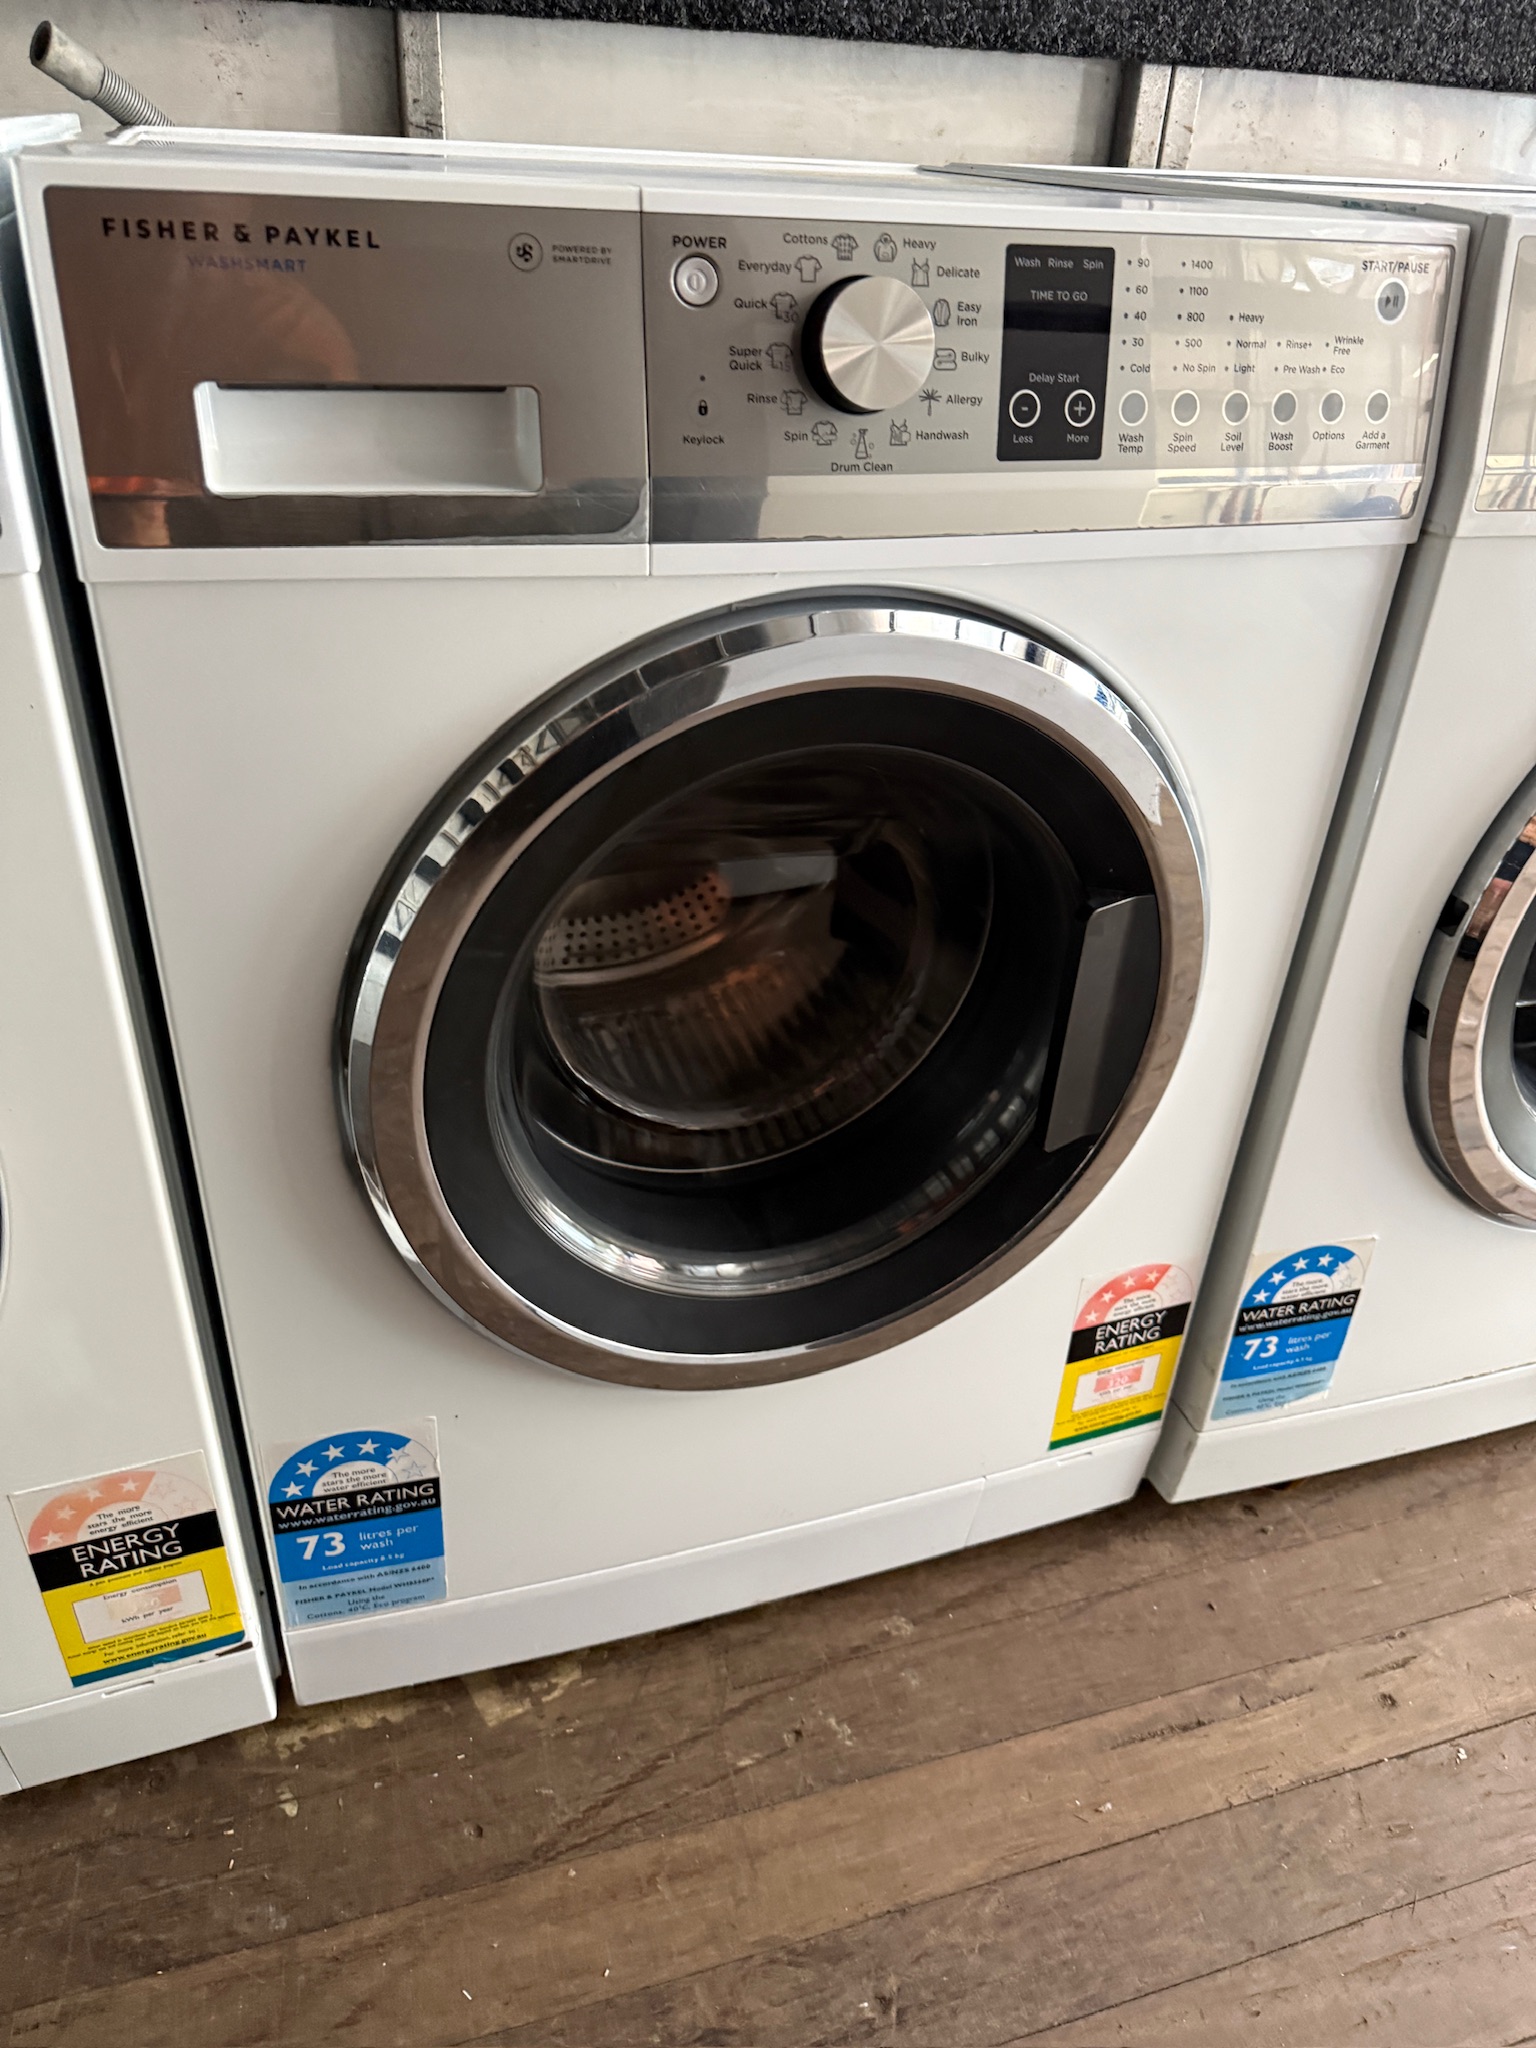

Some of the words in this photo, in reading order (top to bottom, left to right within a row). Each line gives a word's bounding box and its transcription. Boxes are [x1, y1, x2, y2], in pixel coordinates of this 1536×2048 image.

[101, 217, 220, 242] FISHER
[233, 223, 251, 243] &
[264, 225, 380, 249] PAYKEL
[782, 232, 828, 246] Cottons
[672, 235, 727, 249] POWER
[902, 237, 937, 251] Heavy
[551, 244, 598, 254] POWERED
[600, 246, 612, 255] BY
[186, 254, 307, 273] WASHSMART
[551, 255, 612, 265] SMARTDRIVE
[1014, 256, 1042, 270] Wash
[1047, 257, 1074, 270] Rinse
[1082, 258, 1105, 272] Spin
[1137, 258, 1151, 269] 90
[1191, 259, 1214, 271] 1400
[738, 260, 792, 275] Everyday
[936, 266, 981, 279] Delicate
[1361, 259, 1430, 276] START/PAUSE
[1030, 289, 1055, 302] TIME
[1056, 290, 1070, 302] TO
[1071, 290, 1089, 302] GO
[1135, 285, 1149, 296] 60
[1188, 285, 1209, 297] 1100
[733, 298, 768, 311] Quick
[957, 301, 982, 315] Easy
[957, 315, 978, 327] Iron
[1133, 311, 1147, 322] 40
[1186, 312, 1206, 323] 800
[1238, 312, 1265, 325] Heavy
[1131, 337, 1145, 348] 30
[1184, 338, 1203, 349] 500
[1236, 338, 1267, 350] Normal
[1285, 339, 1313, 351] Rinse+
[1334, 335, 1364, 347] Wrinkle
[729, 345, 763, 359] Super
[961, 350, 990, 364] Bulky
[1333, 345, 1351, 356] Free
[729, 359, 763, 373] Quick
[1129, 363, 1151, 374] Cold
[1182, 363, 1196, 374] No
[1197, 363, 1217, 376] Spin
[1234, 362, 1256, 376] Light
[1283, 363, 1297, 375] Pre
[1298, 364, 1321, 375] Wash
[1330, 364, 1345, 375] Eco
[1028, 372, 1054, 386] Delay
[1055, 372, 1080, 384] Start
[746, 393, 778, 405] Rinse
[945, 393, 983, 407] Allergy
[682, 434, 725, 447] Keylock
[783, 430, 809, 443] Spin
[915, 429, 970, 441] Handwash
[1012, 433, 1034, 445] Less
[1066, 433, 1090, 445] More
[1118, 433, 1144, 445] Wash
[1172, 432, 1193, 446] Spin
[1225, 432, 1242, 443] Soil
[1270, 432, 1294, 443] Wash
[1312, 431, 1346, 443] Options
[1361, 430, 1379, 441] Add
[1118, 444, 1143, 456] Temp
[1167, 443, 1197, 455] Speed
[1220, 442, 1244, 453] Level
[1268, 442, 1293, 453] Boost
[1355, 441, 1390, 452] Garment
[830, 461, 861, 473] Drum
[862, 461, 894, 473] Clean
[1242, 1305, 1295, 1323] WATER
[1298, 1294, 1356, 1314] RATING
[1095, 1310, 1168, 1340] ENERGY
[1238, 1307, 1353, 1333] www.waterrating.gov.au
[1094, 1325, 1161, 1355] RATING
[1287, 1335, 1312, 1345] litres
[1314, 1331, 1332, 1342] per
[1243, 1335, 1280, 1361] 73
[1285, 1343, 1310, 1354] wash
[332, 1471, 350, 1479] The
[352, 1467, 376, 1476] more
[321, 1479, 345, 1488] stars
[362, 1472, 387, 1481] more
[323, 1485, 349, 1493] water
[351, 1478, 387, 1489] efficient
[276, 1496, 350, 1520] WATER
[356, 1482, 435, 1508] RATING
[96, 1512, 114, 1520] The
[117, 1504, 141, 1515] more
[277, 1496, 436, 1530] www.waterrating.gov.au
[87, 1521, 108, 1530] stars
[111, 1516, 126, 1524] the
[129, 1510, 153, 1519] more
[89, 1525, 118, 1536] energy
[121, 1516, 154, 1528] efficient
[359, 1528, 393, 1541] litres
[396, 1524, 419, 1537] per
[72, 1522, 180, 1563] ENERGY
[296, 1531, 346, 1560] 73
[360, 1538, 394, 1551] wash
[79, 1540, 183, 1579] RATING
[322, 1562, 343, 1571] Load
[345, 1557, 379, 1569] capacity
[347, 1594, 371, 1606] Using
[372, 1593, 386, 1601] the
[391, 1593, 426, 1607] program
